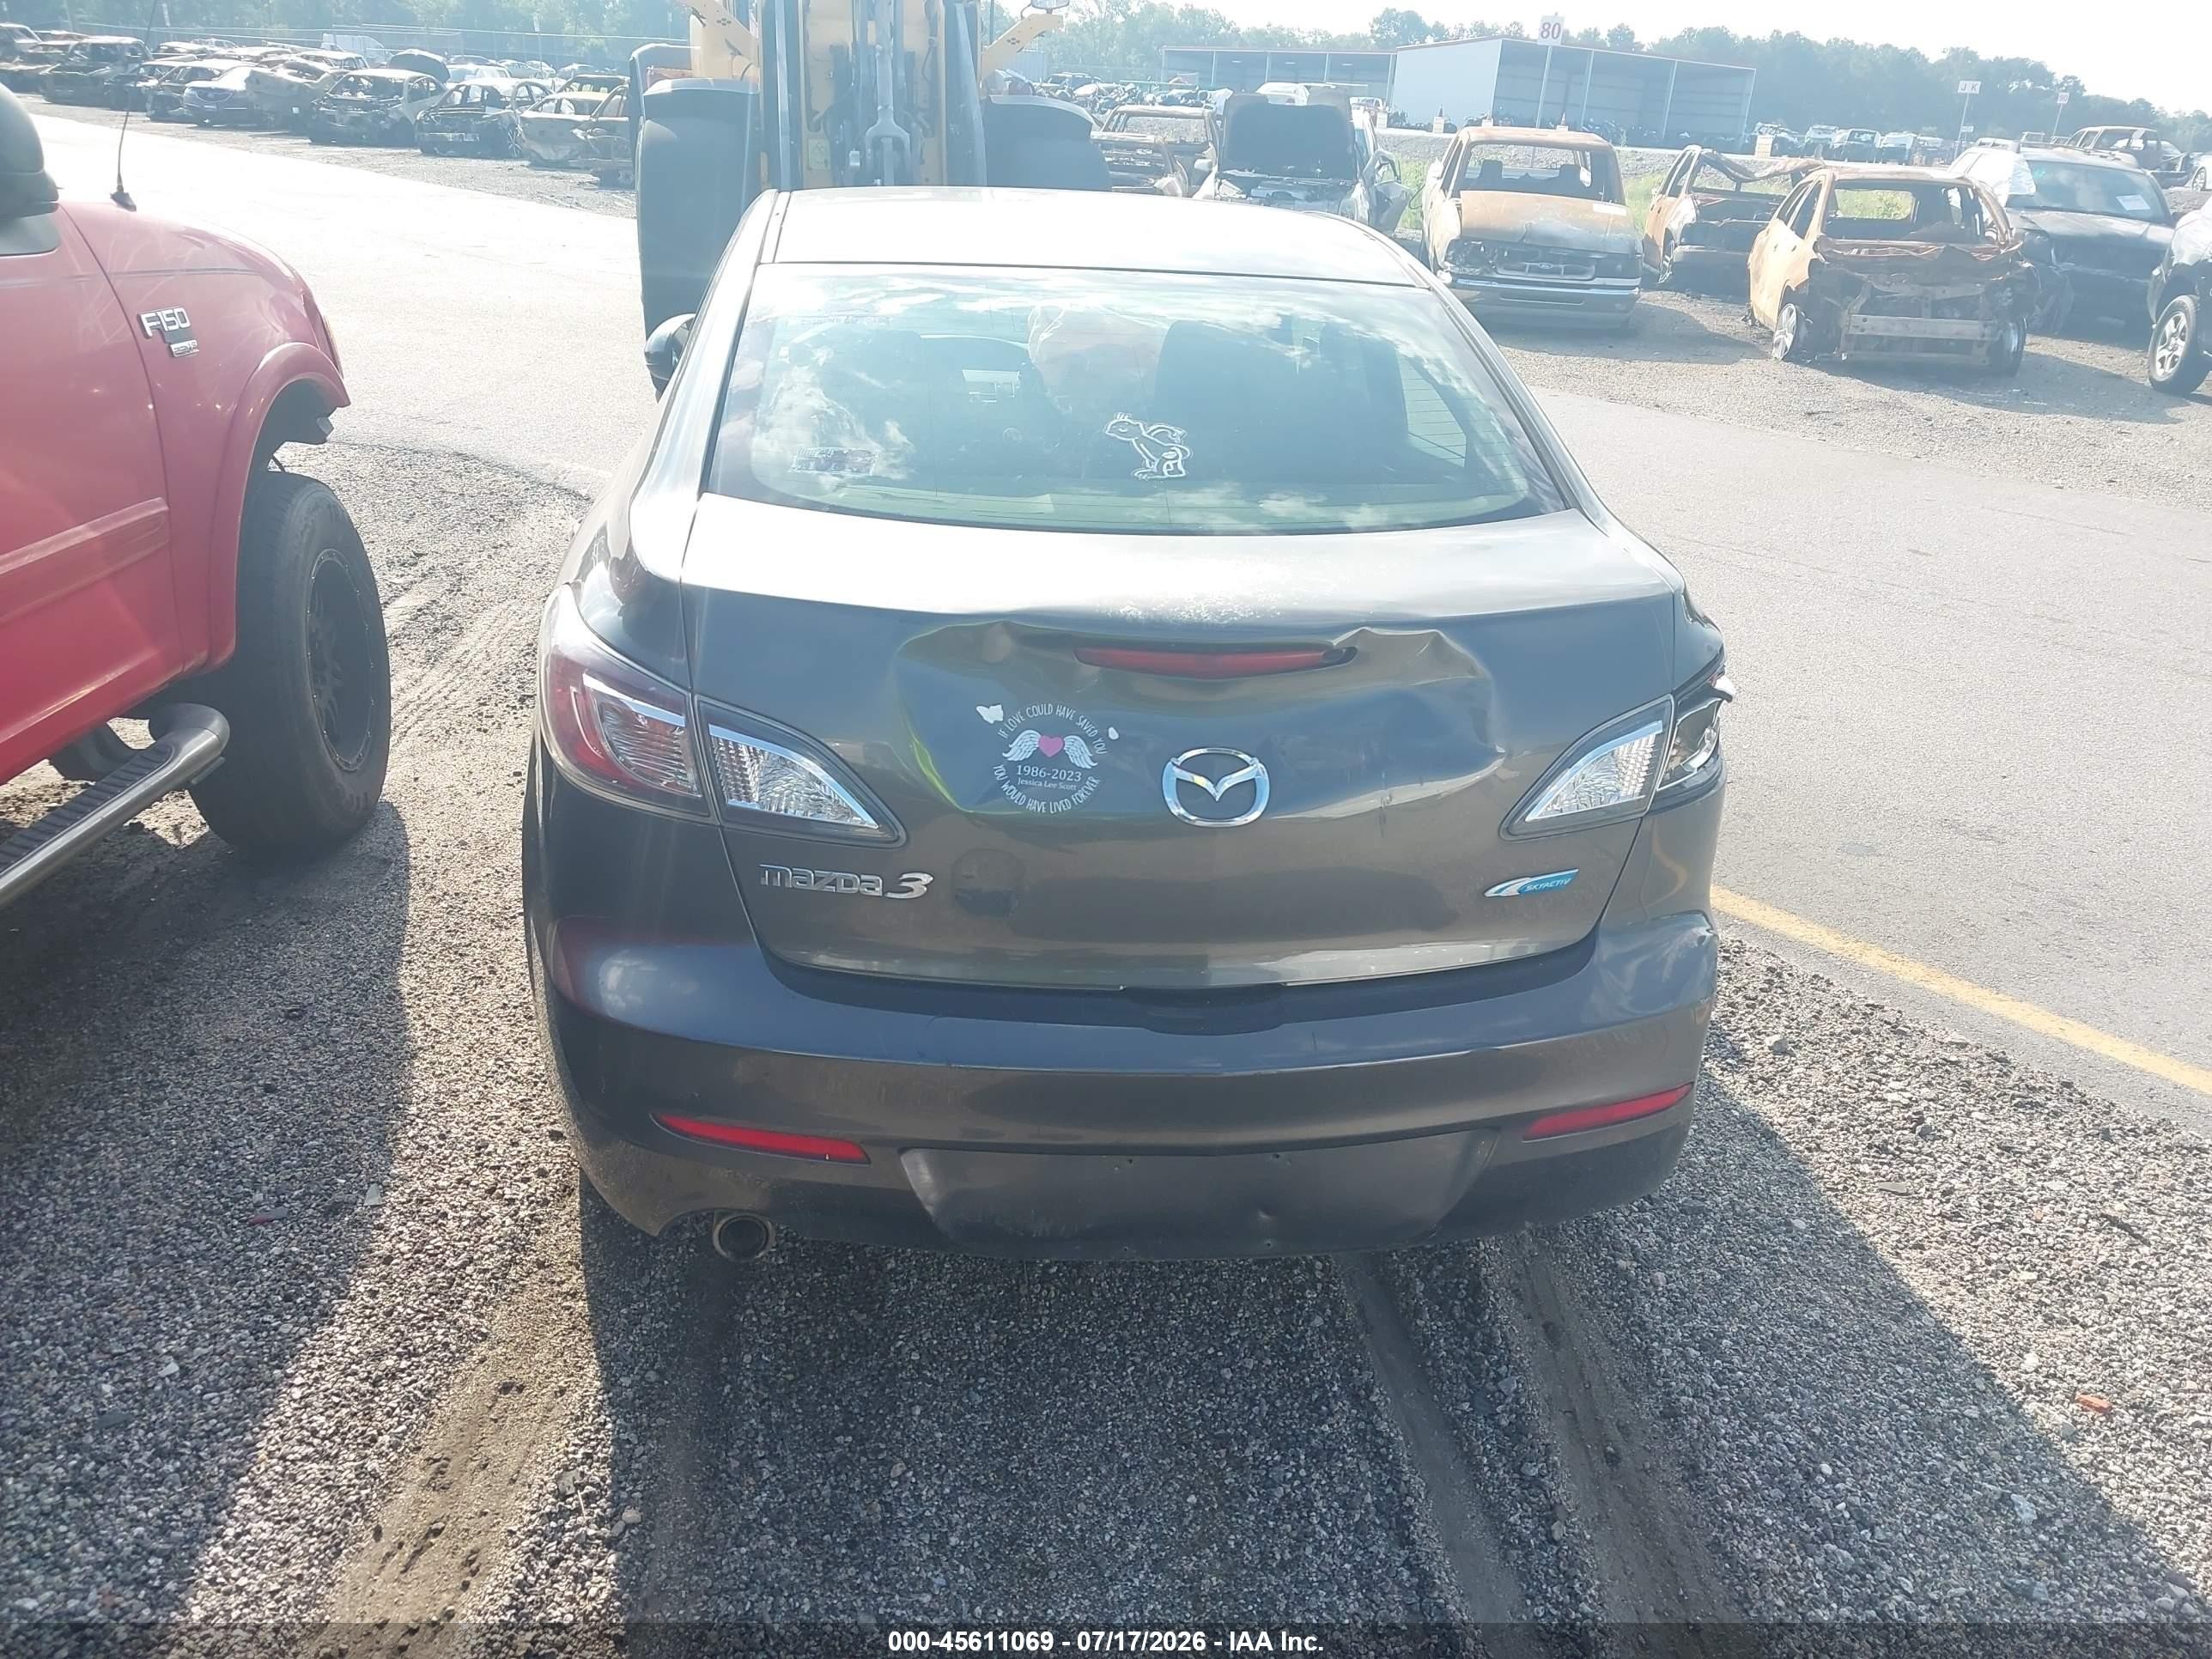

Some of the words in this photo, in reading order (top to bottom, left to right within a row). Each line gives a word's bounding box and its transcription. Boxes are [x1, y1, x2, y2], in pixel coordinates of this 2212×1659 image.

[1540, 21, 1562, 40] 80
[1960, 82, 1967, 91] J
[1971, 82, 1978, 92] K
[998, 728, 1009, 739] IF
[1004, 711, 1025, 732] LOVE
[1025, 703, 1054, 718] COULD
[1055, 704, 1076, 720] HAVE
[1075, 715, 1098, 738] SAVED
[1092, 738, 1108, 755] YOU
[993, 764, 1008, 781] YOU
[1017, 764, 1082, 782] 1986-2023
[1018, 777, 1042, 787] Jessica
[1059, 782, 1078, 791] Scott
[1071, 775, 1102, 806] FOREVER
[1000, 781, 1027, 805] WOULD
[1026, 798, 1047, 813] HAVE
[1049, 799, 1072, 814] LIVED
[1524, 878, 1571, 891] SKYACTIV
